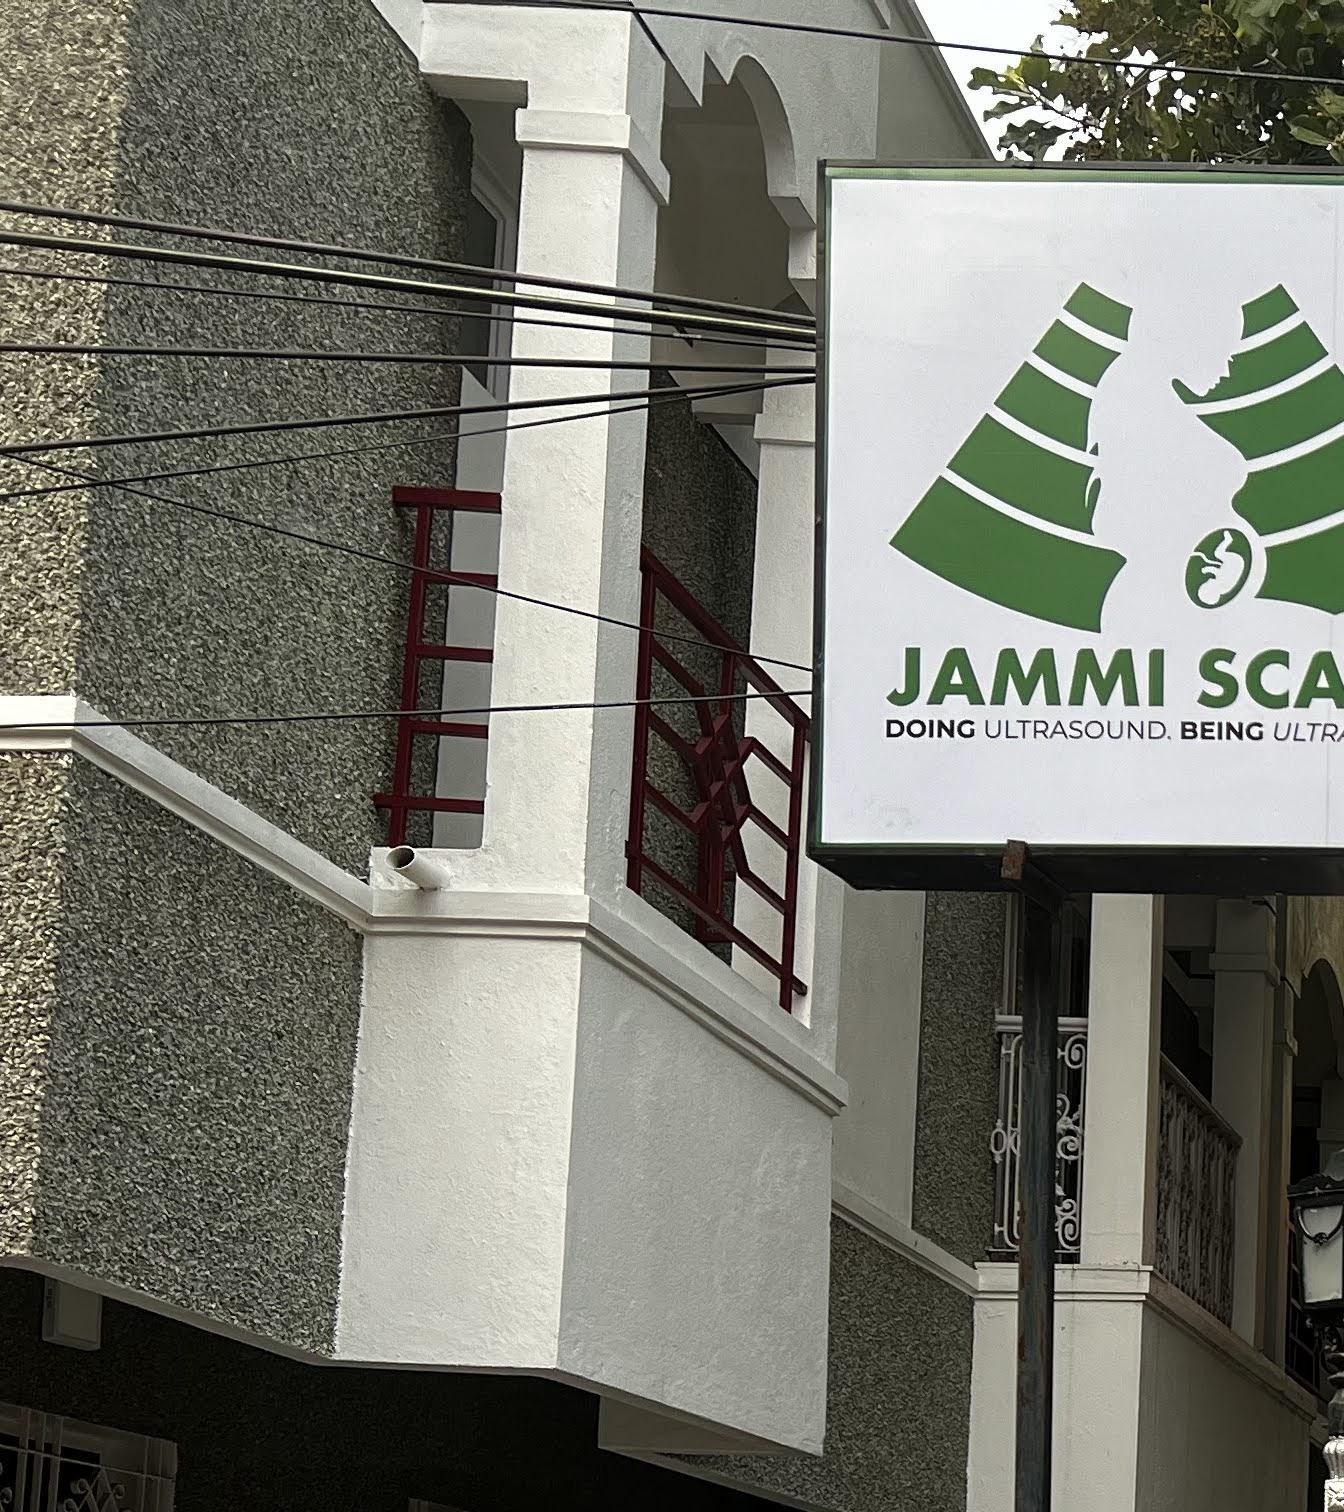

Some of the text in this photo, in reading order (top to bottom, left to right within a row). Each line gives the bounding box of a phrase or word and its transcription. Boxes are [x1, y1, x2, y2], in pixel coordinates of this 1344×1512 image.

[887, 647, 1164, 708] JAMMI
[886, 719, 975, 739] DOING
[985, 719, 1171, 740] ULTRASOUND.
[1181, 720, 1263, 741] BEING
